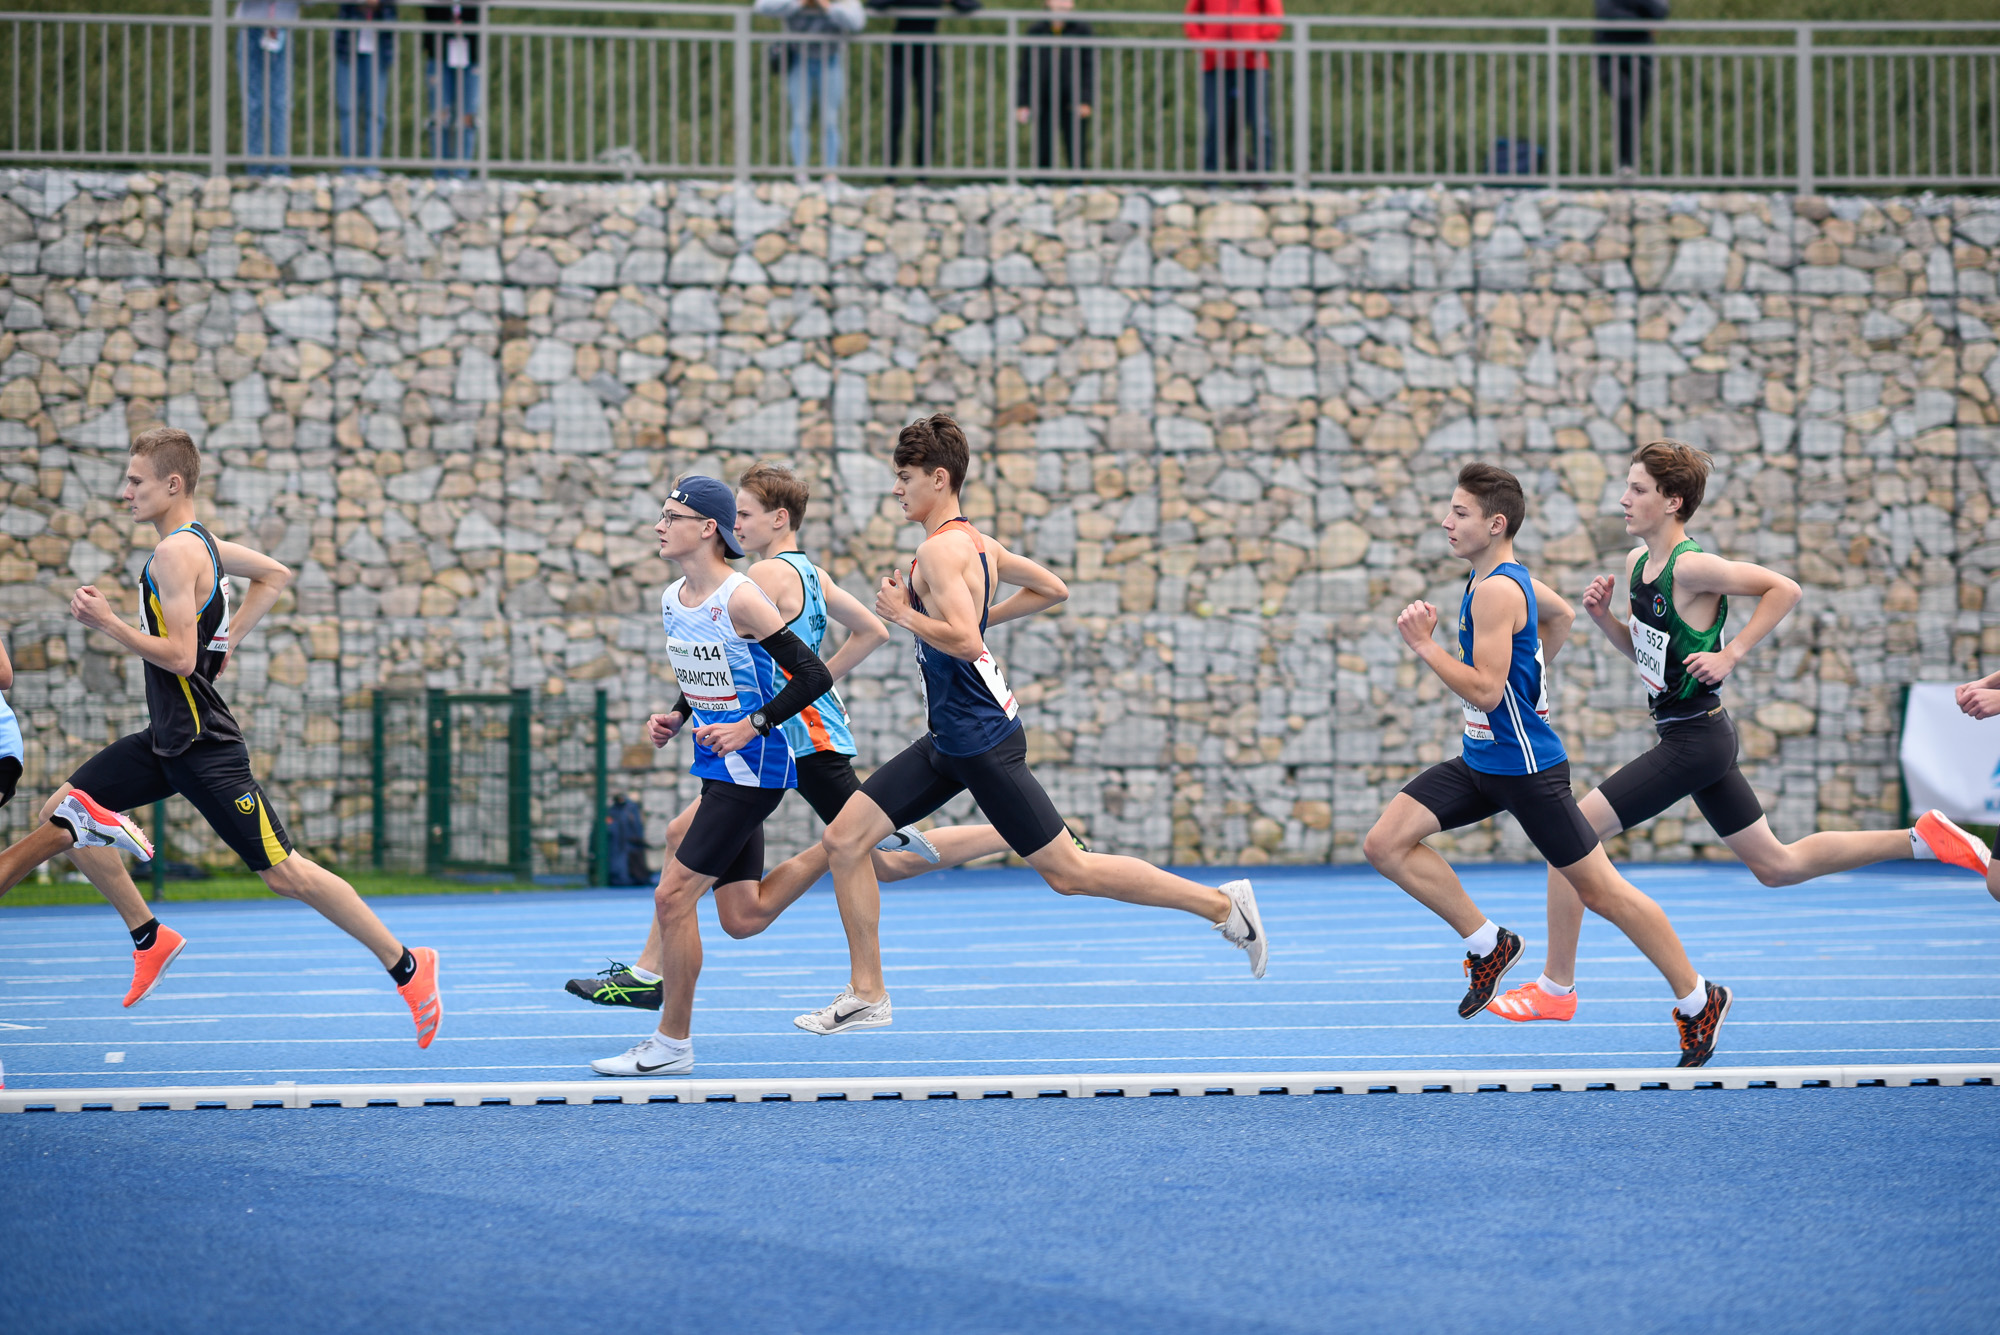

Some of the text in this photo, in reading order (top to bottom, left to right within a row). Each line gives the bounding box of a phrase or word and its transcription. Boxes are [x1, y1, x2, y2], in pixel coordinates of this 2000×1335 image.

[1646, 629, 1663, 651] 552
[693, 645, 721, 661] 414
[1634, 646, 1660, 676] OSICKI
[711, 702, 729, 711] 2021
